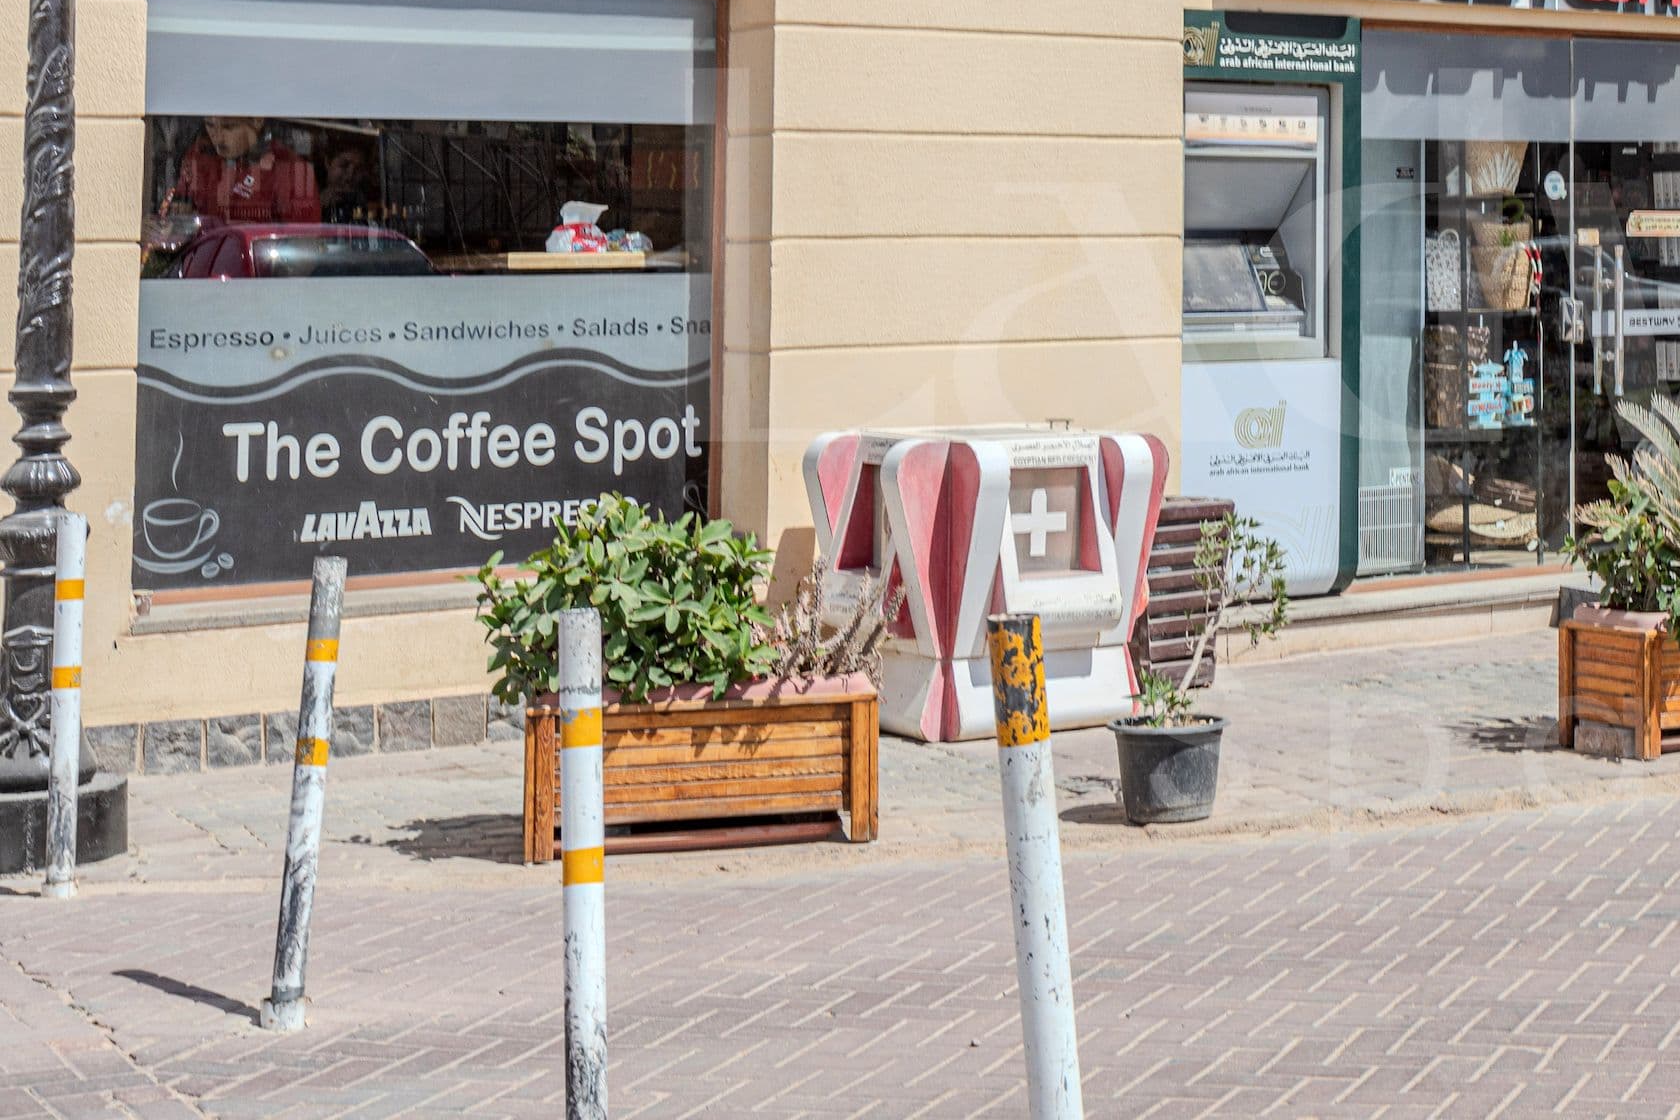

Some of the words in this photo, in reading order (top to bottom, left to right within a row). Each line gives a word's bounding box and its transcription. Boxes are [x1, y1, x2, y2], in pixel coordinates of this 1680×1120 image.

[1219, 55, 1241, 69] arab
[1242, 57, 1274, 70] african
[1274, 58, 1332, 72] international
[1333, 60, 1356, 73] bank
[150, 328, 275, 352] Espresso
[299, 325, 383, 346] Juices
[403, 320, 549, 341] Sandwiches
[572, 317, 648, 338] Salads
[222, 420, 341, 483] The
[360, 410, 557, 475] Coffee
[573, 403, 703, 476] Spot
[1209, 467, 1225, 477] arab
[1226, 466, 1249, 476] african
[1250, 463, 1292, 473] international
[1293, 462, 1310, 471] bank
